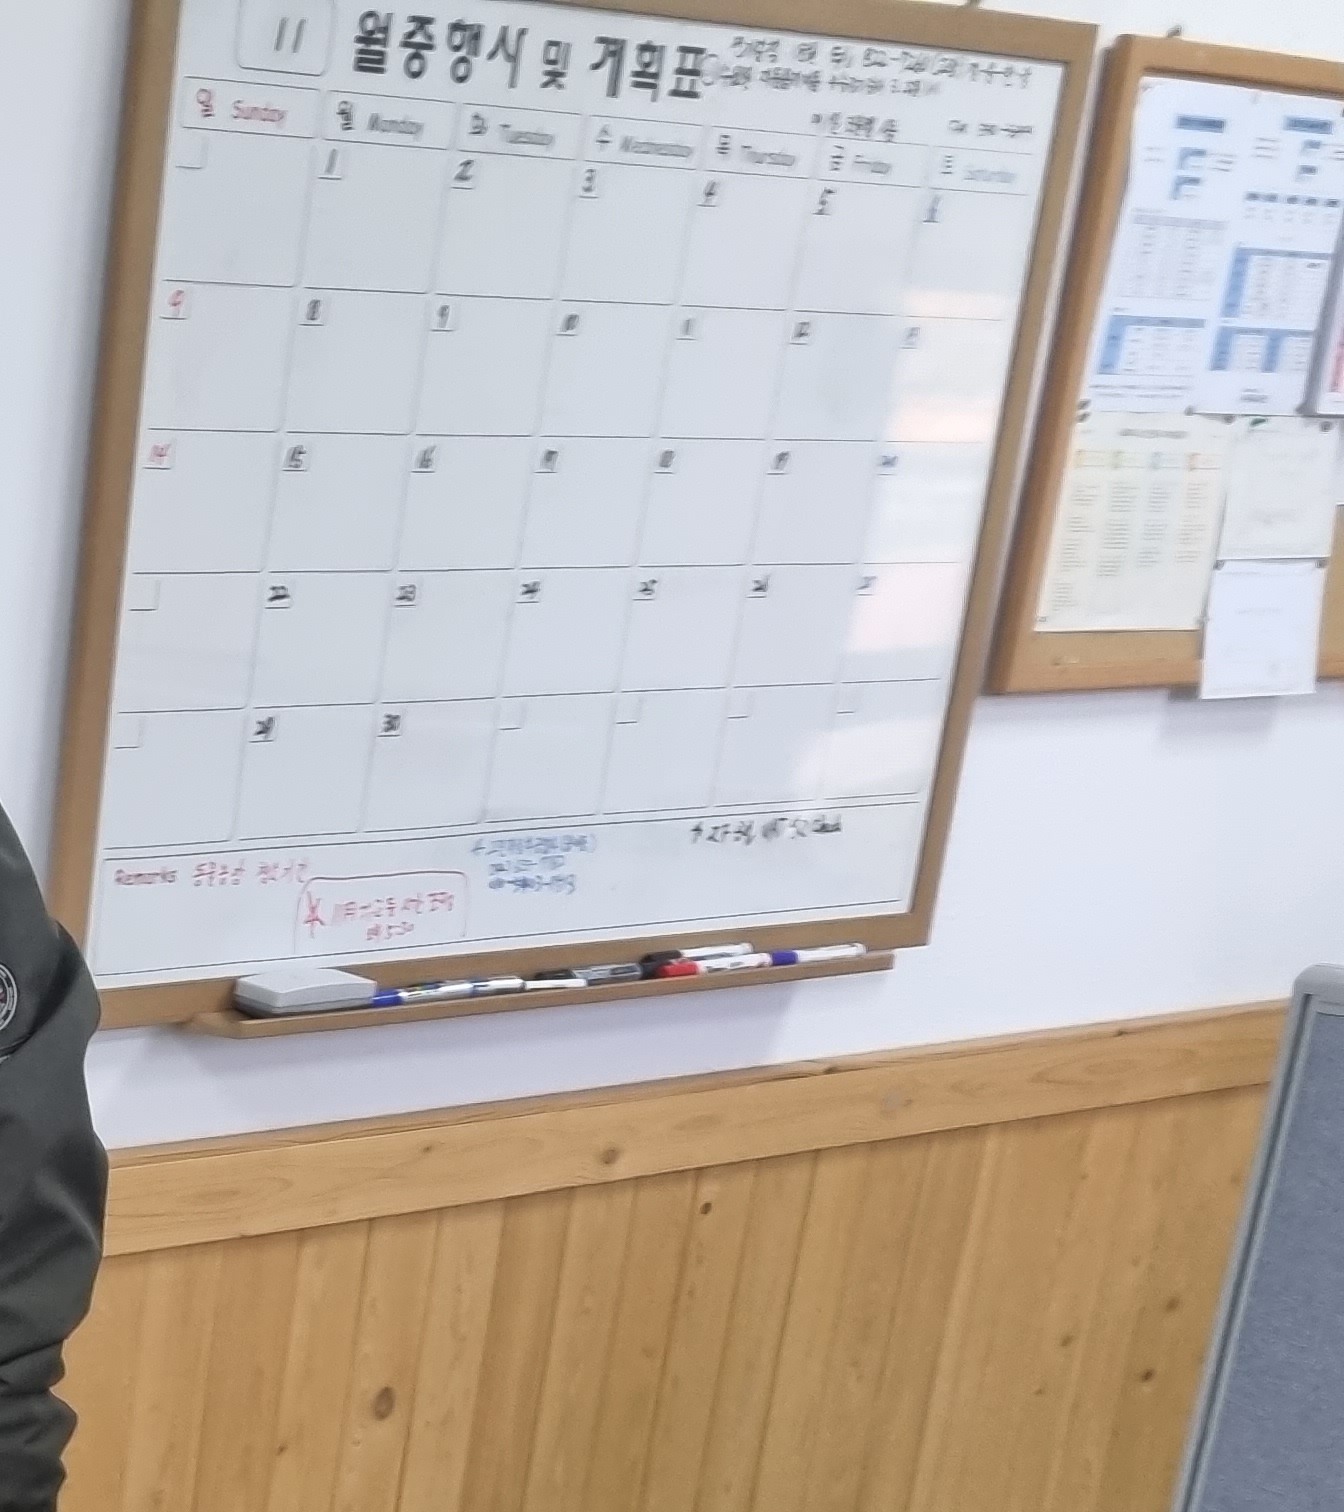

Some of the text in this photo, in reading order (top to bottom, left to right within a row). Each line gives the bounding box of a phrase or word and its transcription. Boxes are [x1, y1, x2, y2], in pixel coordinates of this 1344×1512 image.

[274, 17, 306, 53] 11
[540, 39, 572, 90] 및
[589, 35, 706, 103] 계획표
[196, 88, 215, 118] 일
